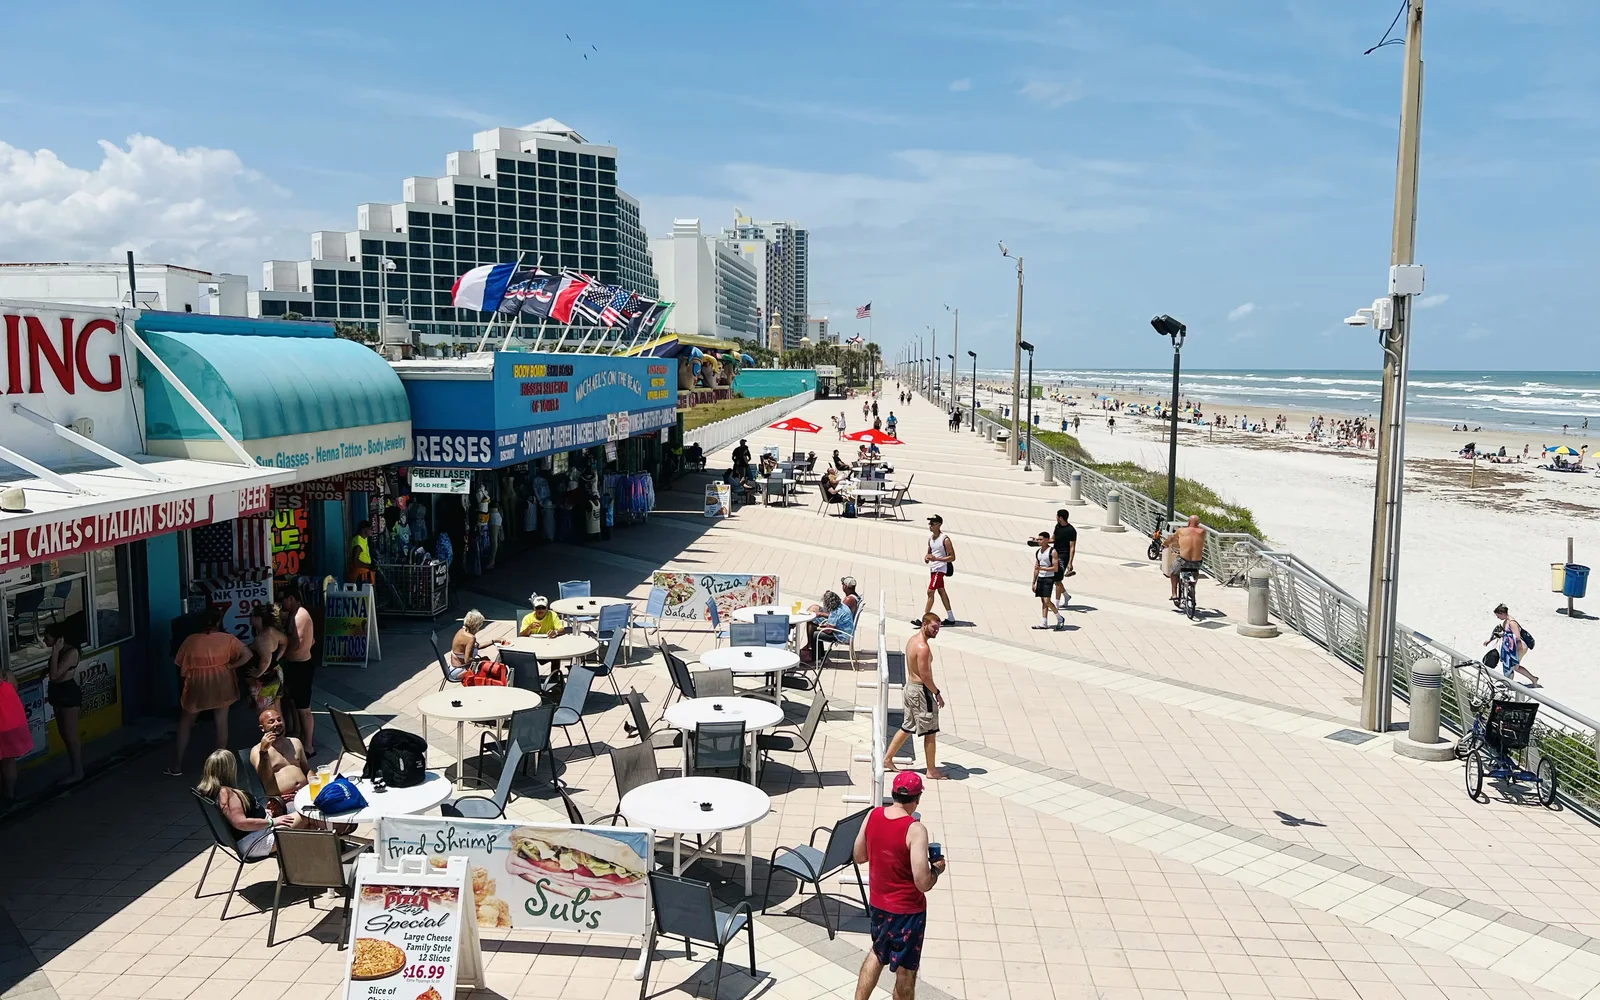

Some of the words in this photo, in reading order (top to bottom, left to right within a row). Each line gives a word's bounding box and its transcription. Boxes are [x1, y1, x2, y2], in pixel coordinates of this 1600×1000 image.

[0, 314, 122, 395] ING
[513, 364, 529, 378] BODY
[530, 364, 546, 378] BOARD
[575, 370, 607, 404] MICHAEL'S
[607, 370, 617, 385] ON
[617, 371, 627, 387] THE
[627, 373, 642, 397] BEACH
[256, 455, 274, 466] Sun
[276, 451, 309, 468] Glasses
[315, 446, 339, 463] Henna
[340, 442, 362, 459] Tattoo
[411, 435, 491, 463] RESSES
[412, 469, 440, 478] GREEN
[443, 470, 470, 478] LASER
[346, 480, 375, 491] ASSES
[238, 485, 267, 513] BEER
[26, 521, 83, 560] CAKES
[94, 506, 153, 543] ITALIAN
[158, 498, 194, 530] SUBS
[219, 580, 263, 590] DIES
[235, 588, 268, 598] TOPS
[700, 575, 743, 595] Pizza
[326, 596, 369, 618] HENNA
[664, 604, 697, 620] Salads
[325, 635, 368, 657] TATTOOS
[388, 833, 428, 860] Fried
[433, 826, 498, 854] Shrimp
[383, 891, 430, 912] PIZZA
[524, 877, 602, 930] Subs
[364, 912, 450, 935] Special
[403, 932, 425, 942] Large
[426, 933, 453, 943] Cheese
[405, 942, 432, 954] Family
[434, 943, 452, 954] Style
[418, 953, 428, 962] 12
[428, 953, 451, 963] Slices
[402, 964, 445, 980] $16.99
[368, 986, 387, 995] Slice
[388, 987, 397, 995] of
